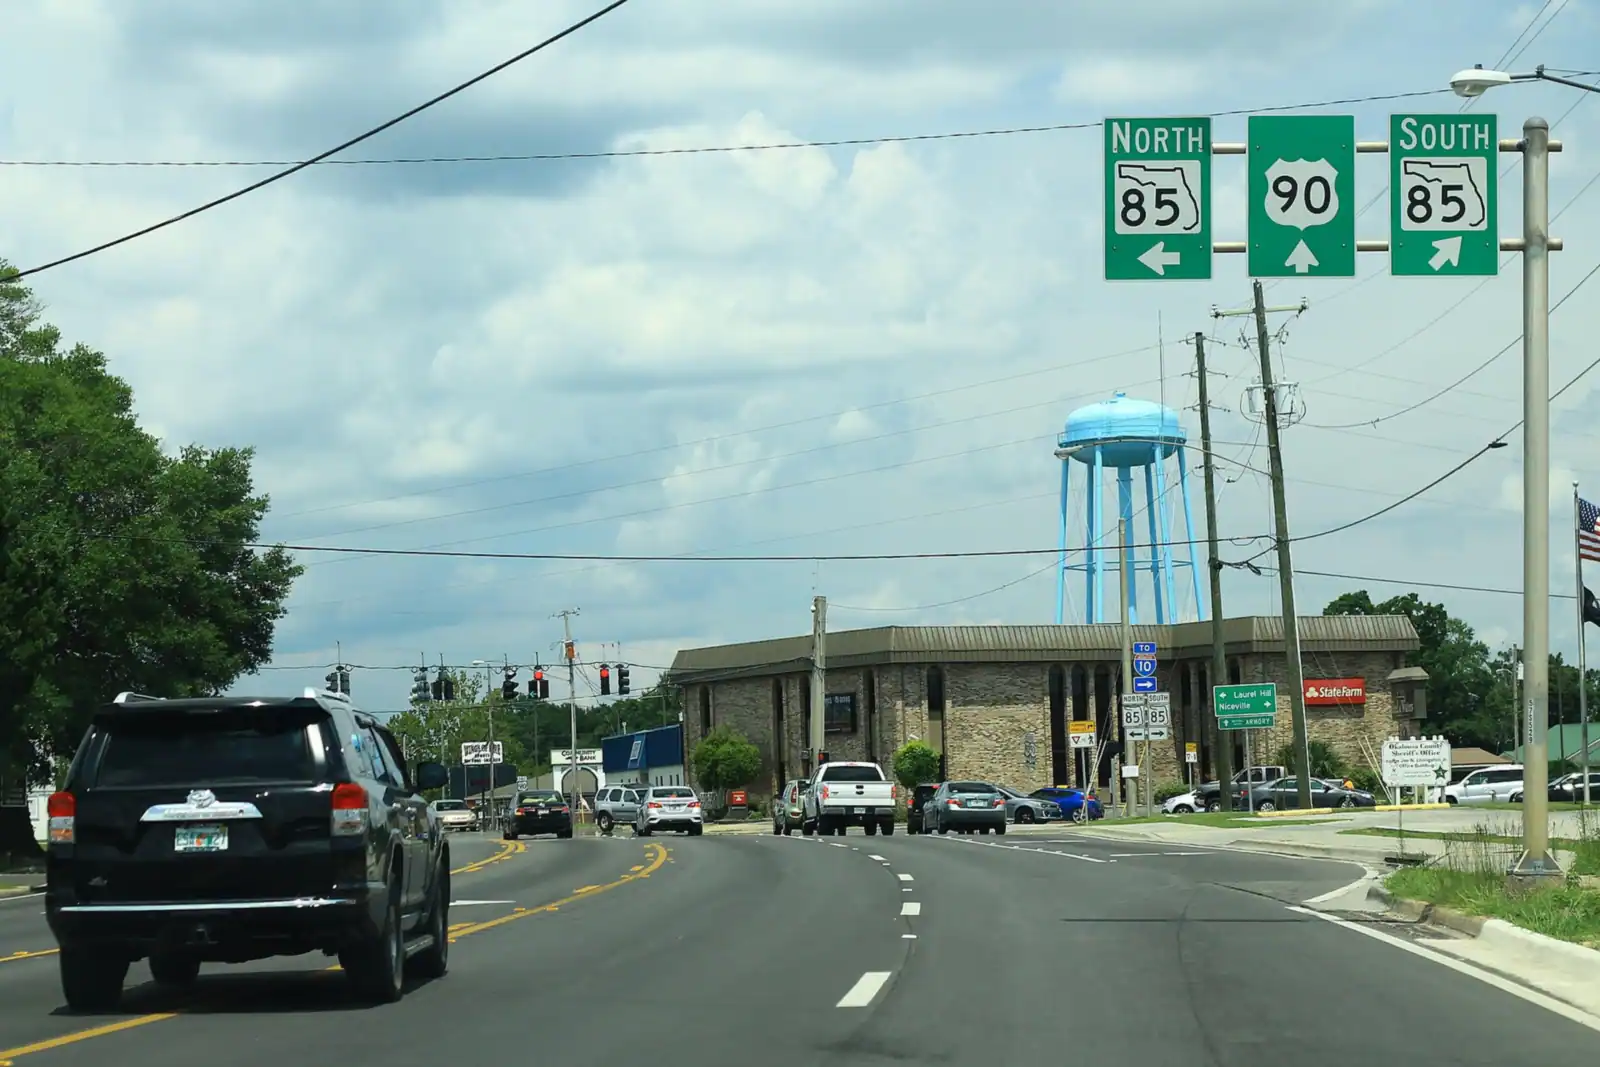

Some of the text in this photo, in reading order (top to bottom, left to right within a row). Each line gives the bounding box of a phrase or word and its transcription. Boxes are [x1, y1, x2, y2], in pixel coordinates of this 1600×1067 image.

[1111, 121, 1203, 154] NORTH
[1400, 117, 1490, 150] SOUTH
[1272, 174, 1331, 215] 90
[1120, 187, 1180, 227] 85
[1406, 184, 1466, 224] 85
[1138, 644, 1150, 652] TO
[1139, 661, 1151, 671] 10
[1233, 689, 1272, 699] Laurel Hill
[1219, 702, 1251, 711] Niceville
[1125, 711, 1140, 724] 85
[1150, 710, 1166, 723] 85
